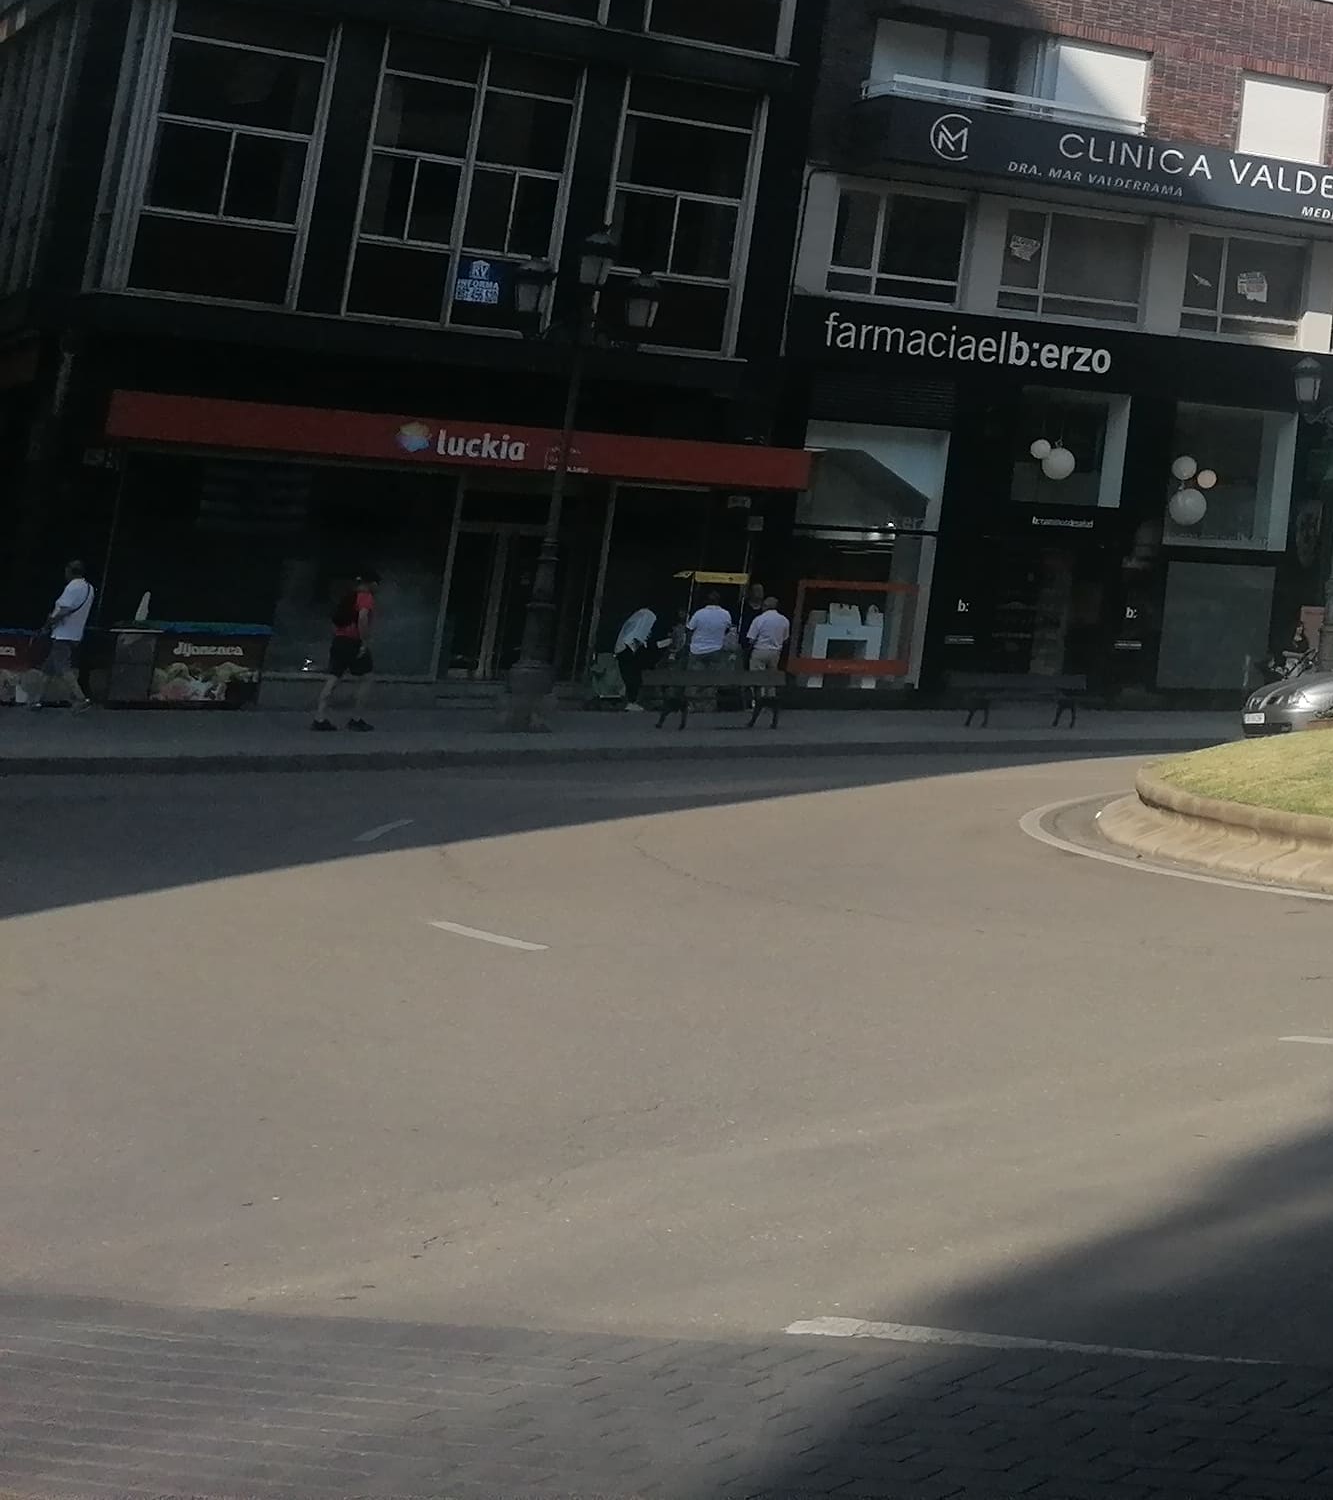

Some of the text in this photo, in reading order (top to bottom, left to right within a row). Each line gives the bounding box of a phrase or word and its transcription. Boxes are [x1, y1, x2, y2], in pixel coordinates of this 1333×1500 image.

[1059, 133, 1212, 180] CLINICA
[1008, 161, 1184, 198] DRA. MAR VALDERRAMA
[436, 428, 527, 462] luckia
[957, 598, 970, 613] b:
[1125, 606, 1138, 620] b:
